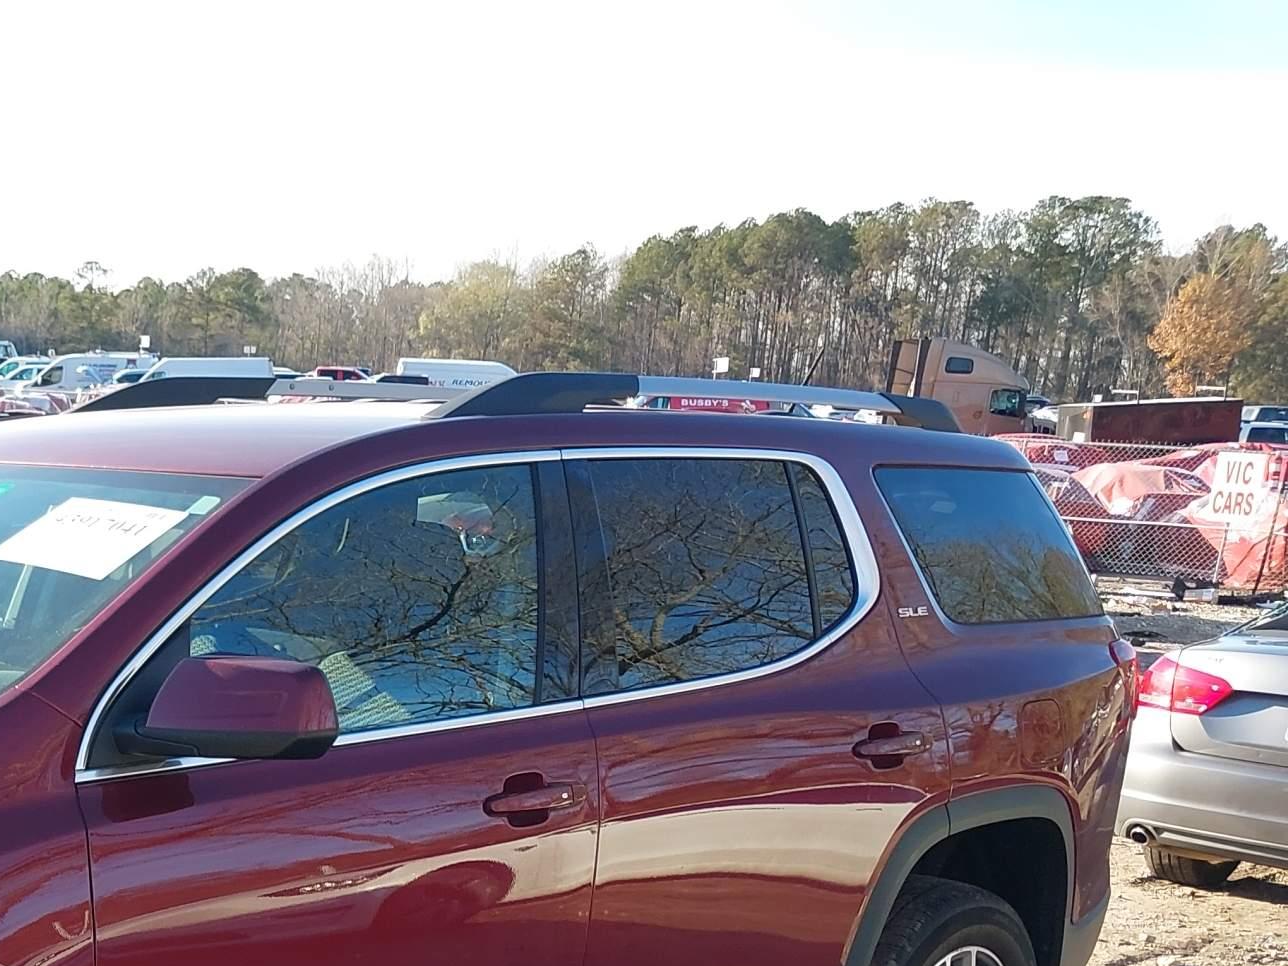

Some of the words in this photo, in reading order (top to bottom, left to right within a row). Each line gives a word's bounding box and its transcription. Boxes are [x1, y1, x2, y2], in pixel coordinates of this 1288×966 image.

[680, 398, 729, 407] BUSBY'S
[1226, 461, 1254, 484] VIC
[1212, 491, 1254, 516] CARS
[897, 606, 929, 618] SLE
